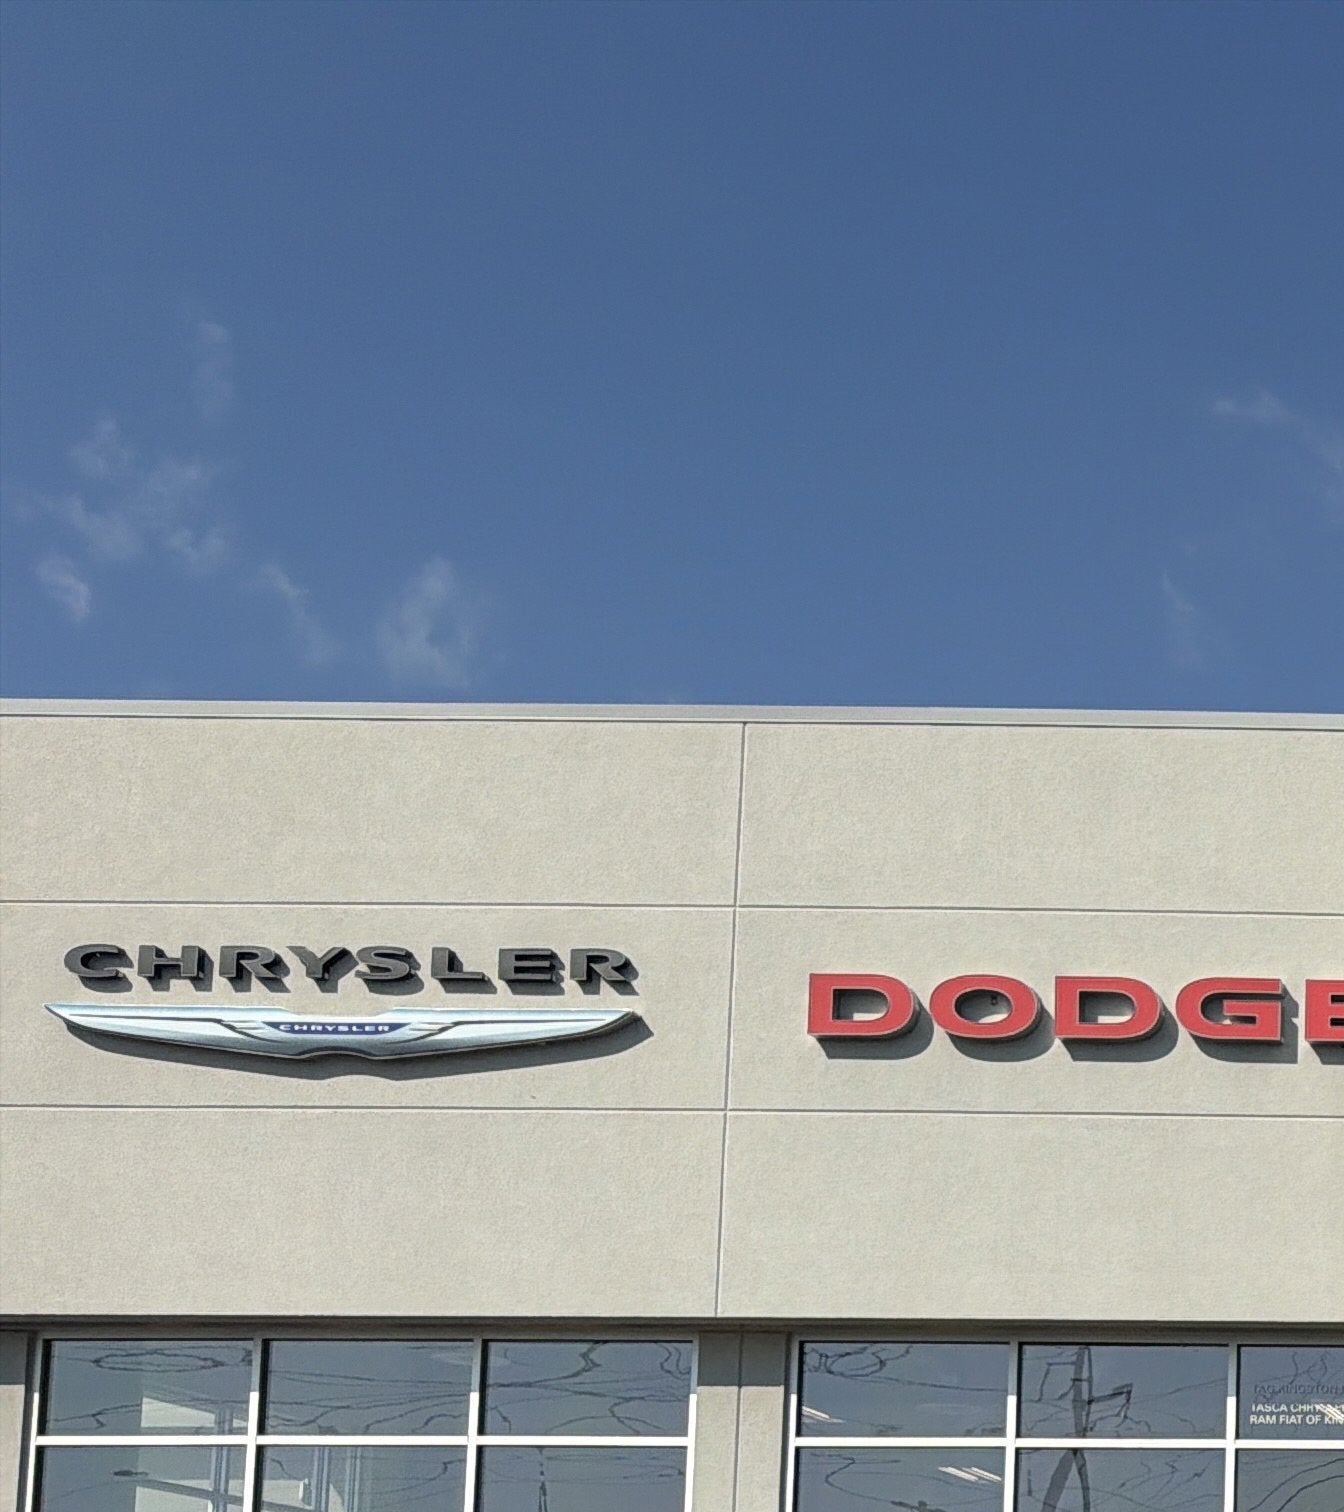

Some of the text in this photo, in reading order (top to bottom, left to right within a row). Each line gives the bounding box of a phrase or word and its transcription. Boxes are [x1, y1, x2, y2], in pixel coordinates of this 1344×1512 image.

[63, 943, 634, 982] CHRYSLER
[279, 1024, 390, 1032] CHRYSLER
[1251, 1403, 1288, 1412] TASCA
[1249, 1415, 1277, 1424] RAM
[1279, 1415, 1303, 1424] FIAT
[1305, 1415, 1321, 1424] OF
